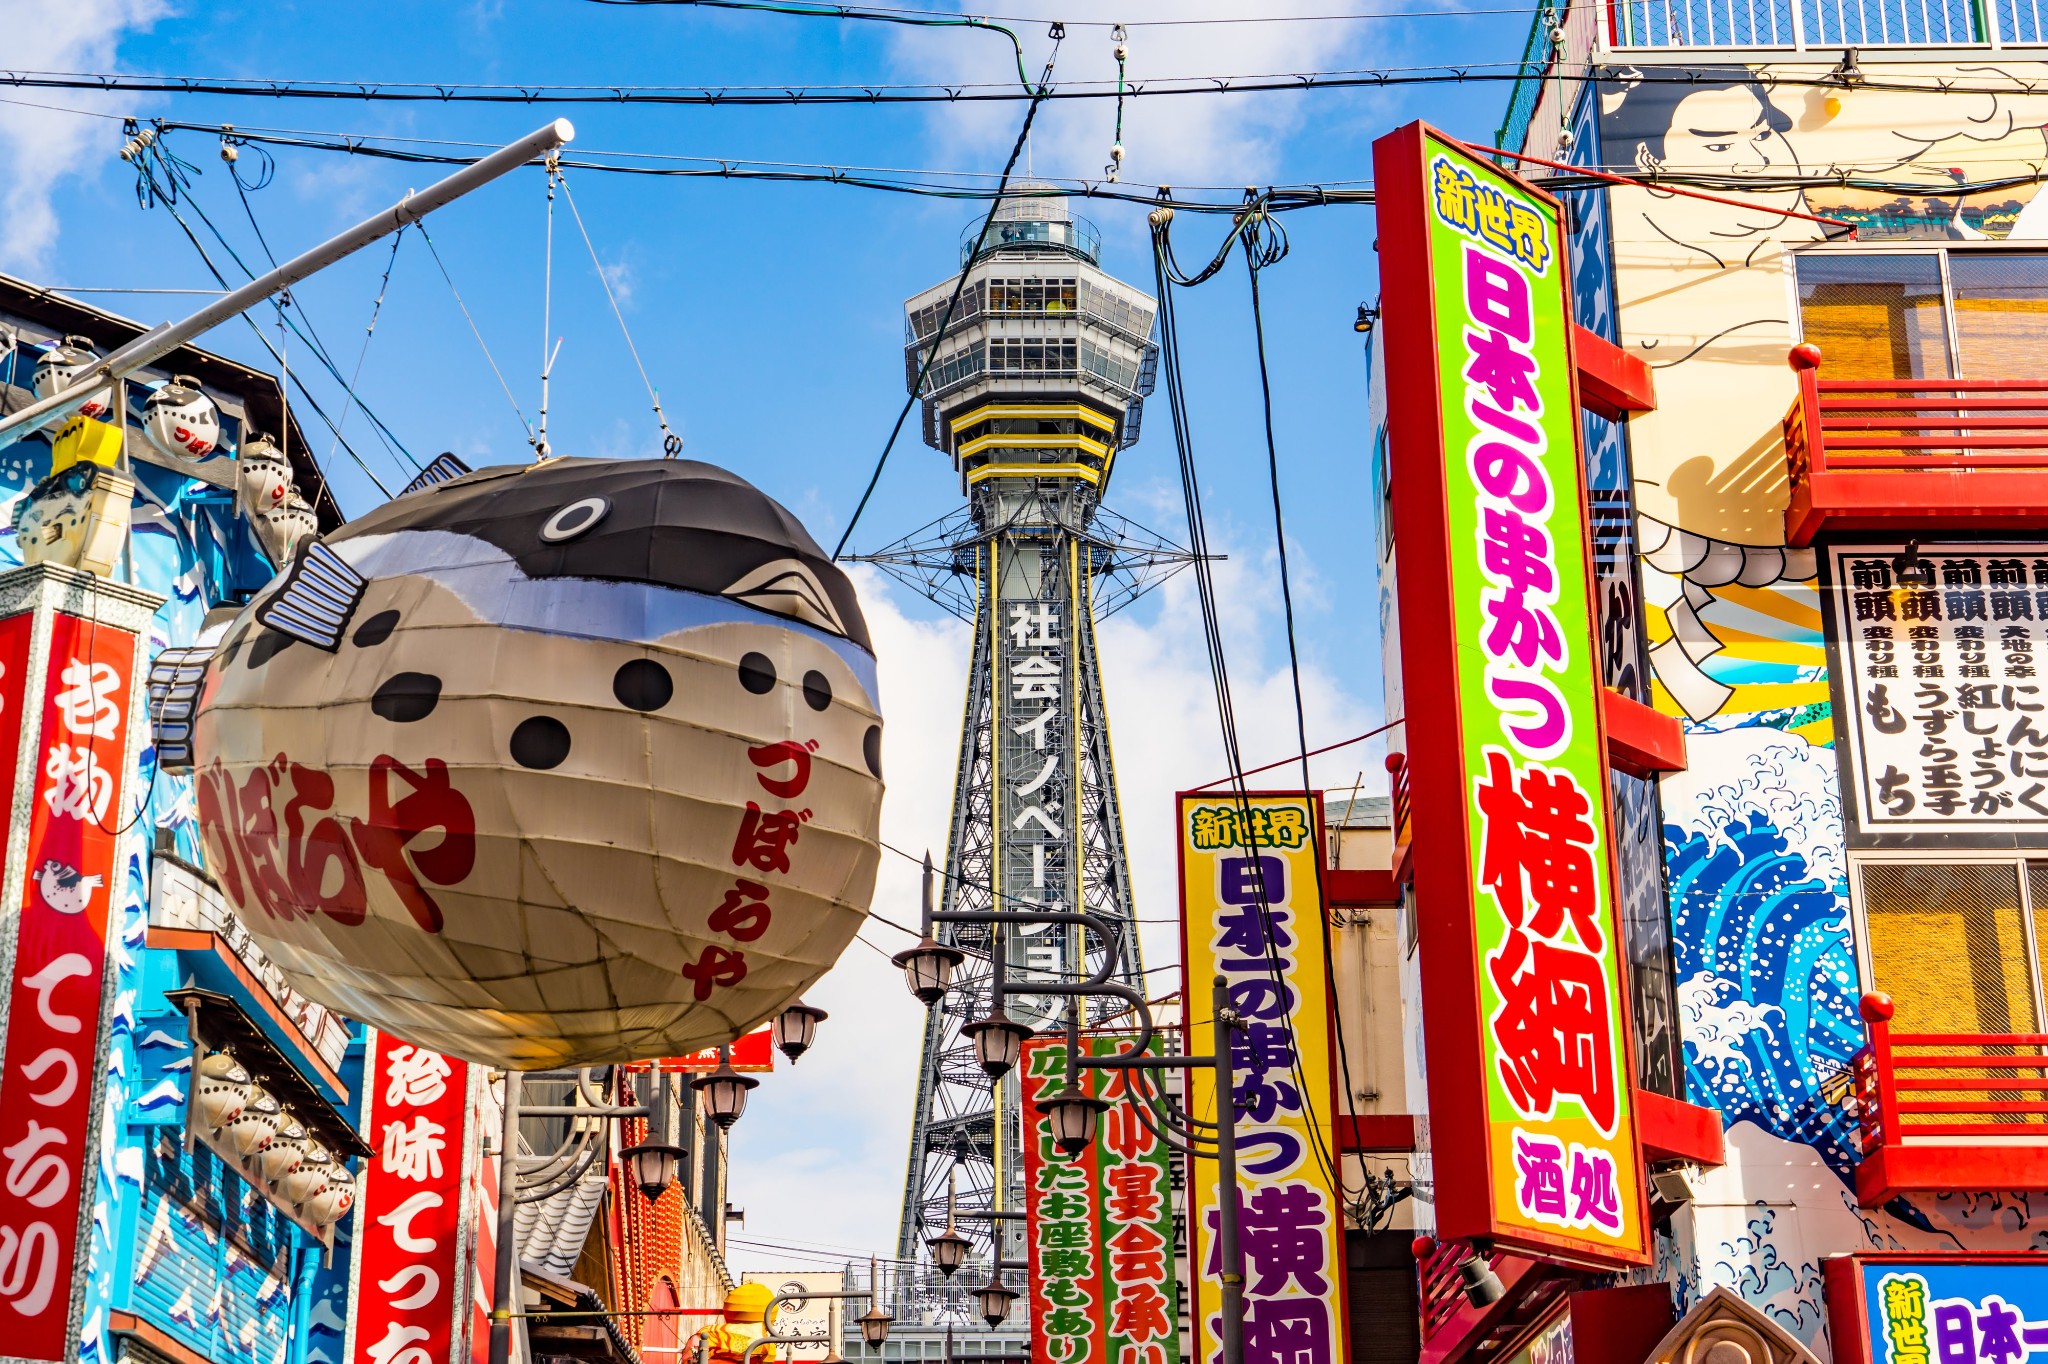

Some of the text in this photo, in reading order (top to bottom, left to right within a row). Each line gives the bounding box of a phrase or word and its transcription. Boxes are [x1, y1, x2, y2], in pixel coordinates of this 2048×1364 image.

[1436, 160, 1550, 271] 新世界
[1850, 559, 1915, 816] 前頭 変わり種 もち
[1908, 626, 1945, 678] 変わり種
[1913, 682, 1967, 816] うずら玉子
[1941, 559, 2014, 816] 前頭 変わり種 紅しょうが
[1986, 558, 2048, 816] 前頭 大地の幸 にんにく
[680, 739, 820, 1001] づぼらや
[1009, 603, 1064, 1032] 社会イノベーション
[1194, 807, 1308, 848] 新世界
[0, 953, 93, 1316] てっちり
[1104, 1042, 1170, 1364] 大小宴会承
[1517, 1135, 1618, 1229] 酒処
[1884, 1278, 1930, 1364] 新世
